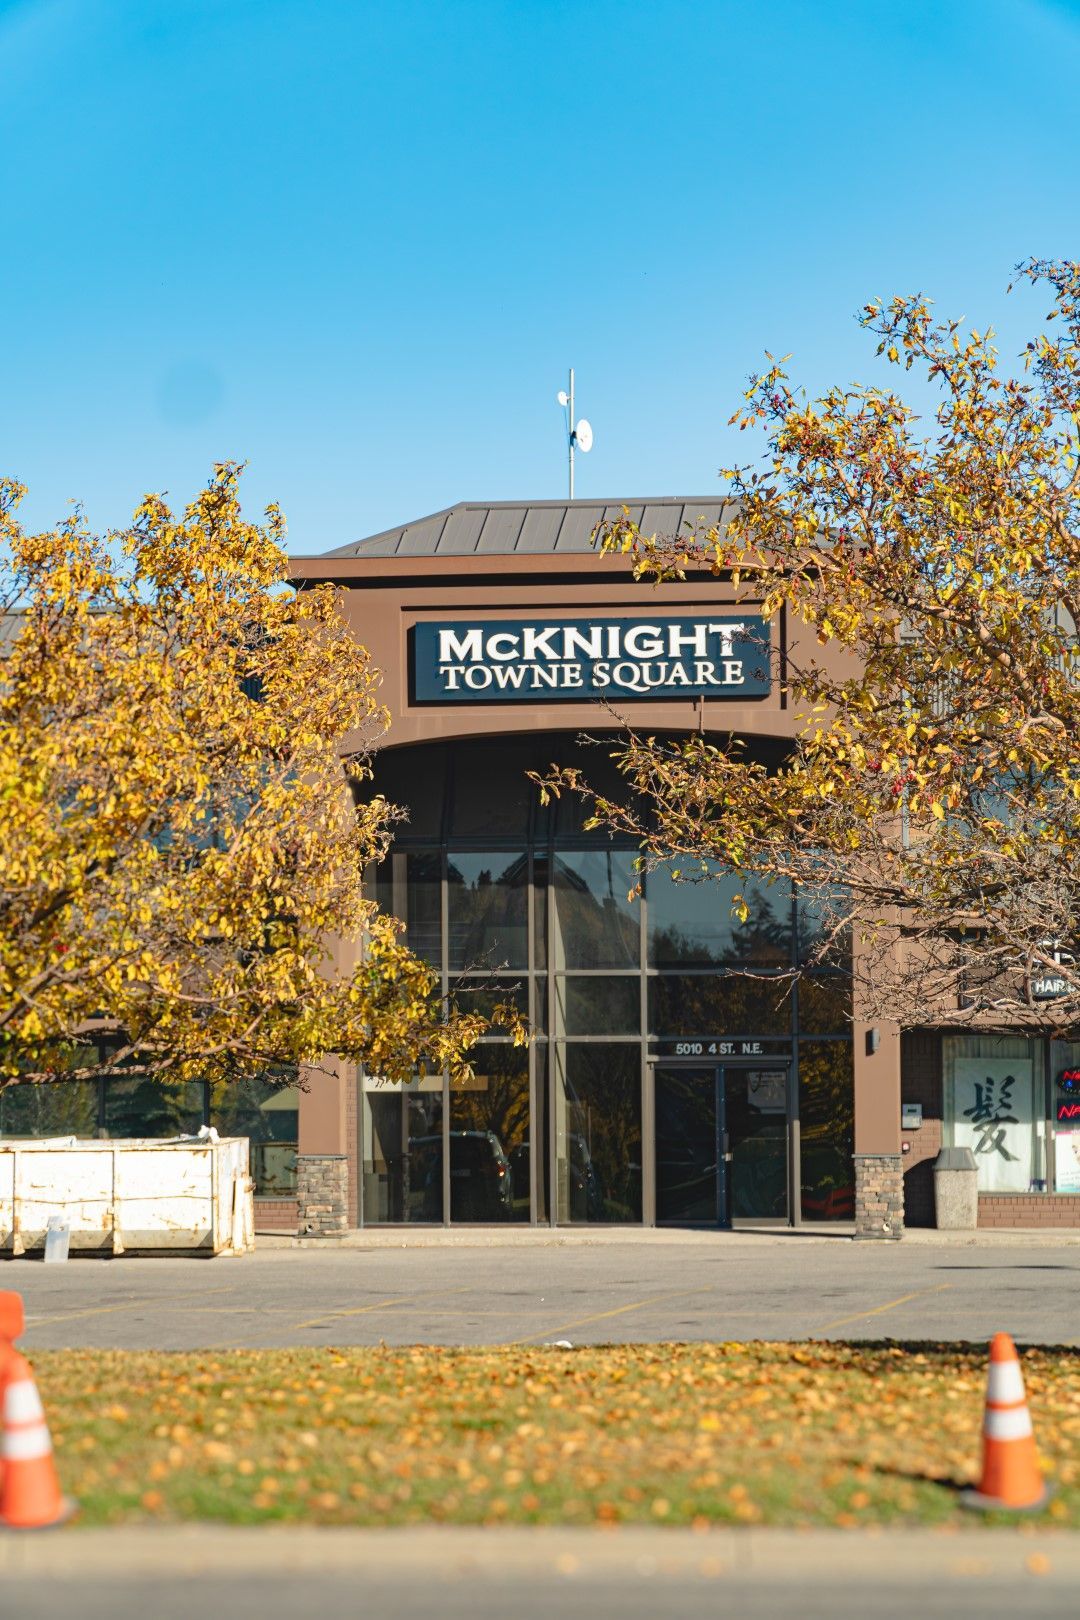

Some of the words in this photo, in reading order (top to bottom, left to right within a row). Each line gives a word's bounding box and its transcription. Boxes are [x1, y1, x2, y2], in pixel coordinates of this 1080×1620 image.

[439, 663, 583, 690] TOWNE
[592, 660, 745, 692] SQUARE
[676, 1043, 702, 1055] 5010
[708, 1043, 717, 1054] 4
[719, 1043, 736, 1055] ST.
[742, 1043, 763, 1054] N.E.
